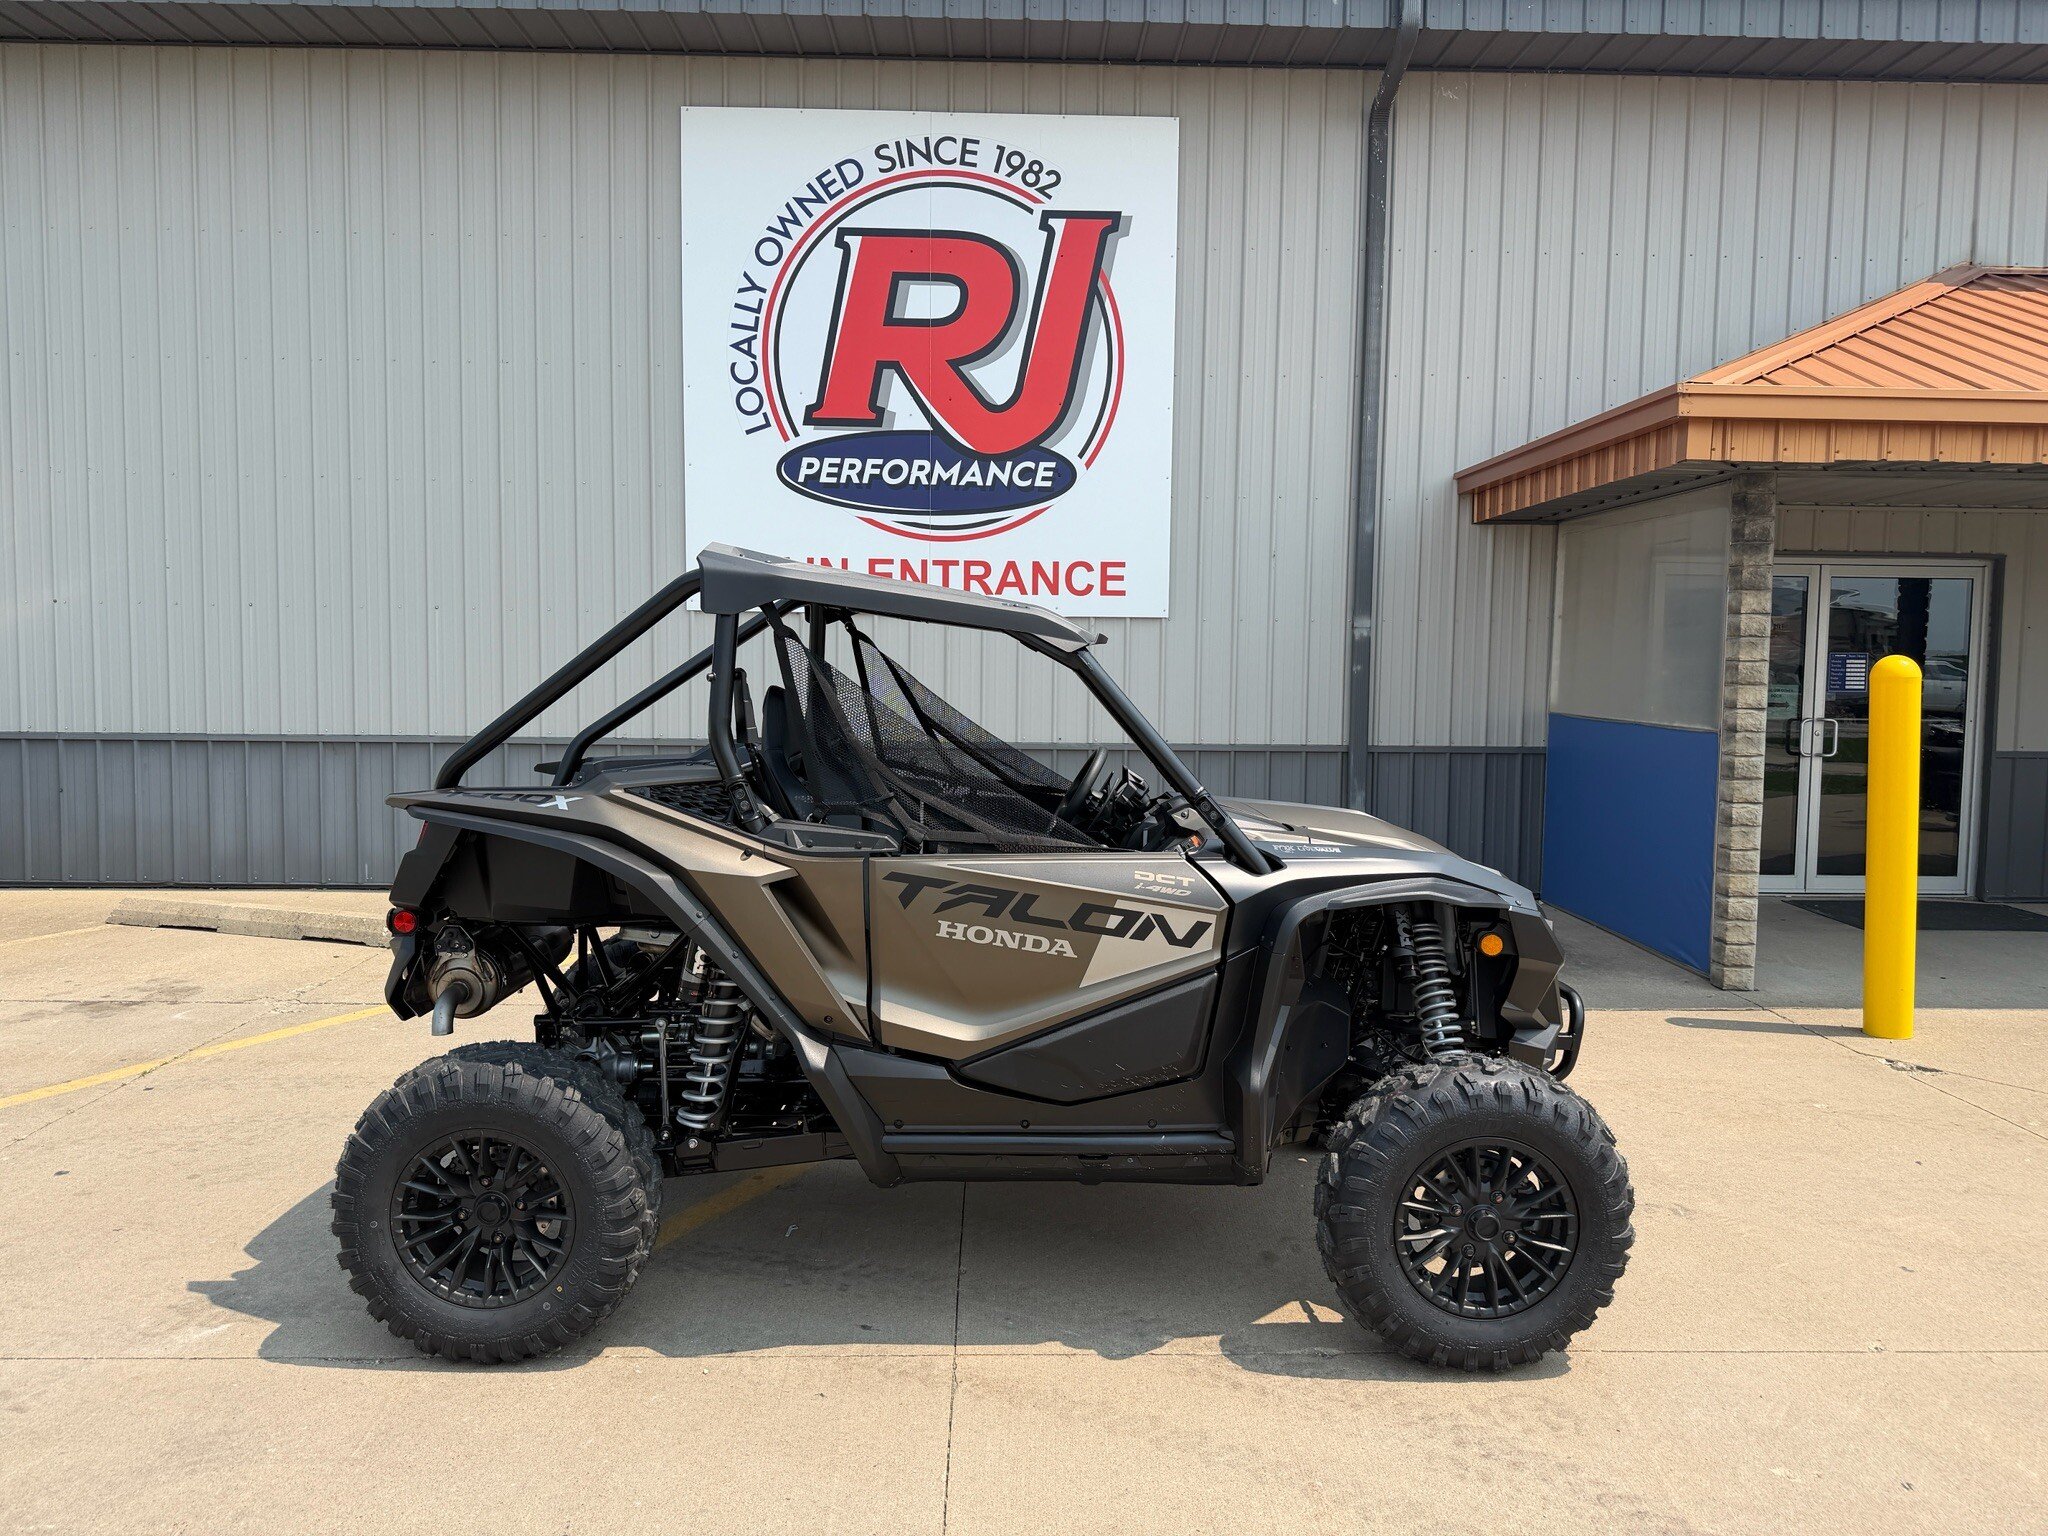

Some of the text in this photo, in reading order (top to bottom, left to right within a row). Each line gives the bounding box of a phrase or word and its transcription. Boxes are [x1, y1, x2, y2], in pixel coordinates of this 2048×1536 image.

[730, 136, 1063, 436] LOCALLY OWNED SINCE 1982
[803, 210, 1123, 459] RJ
[797, 457, 1057, 488] PERFORMANCE
[868, 558, 1127, 597] ENTRANCE
[1134, 870, 1196, 887] DCT
[881, 870, 1213, 949] TALON
[935, 919, 1078, 959] HONDA
